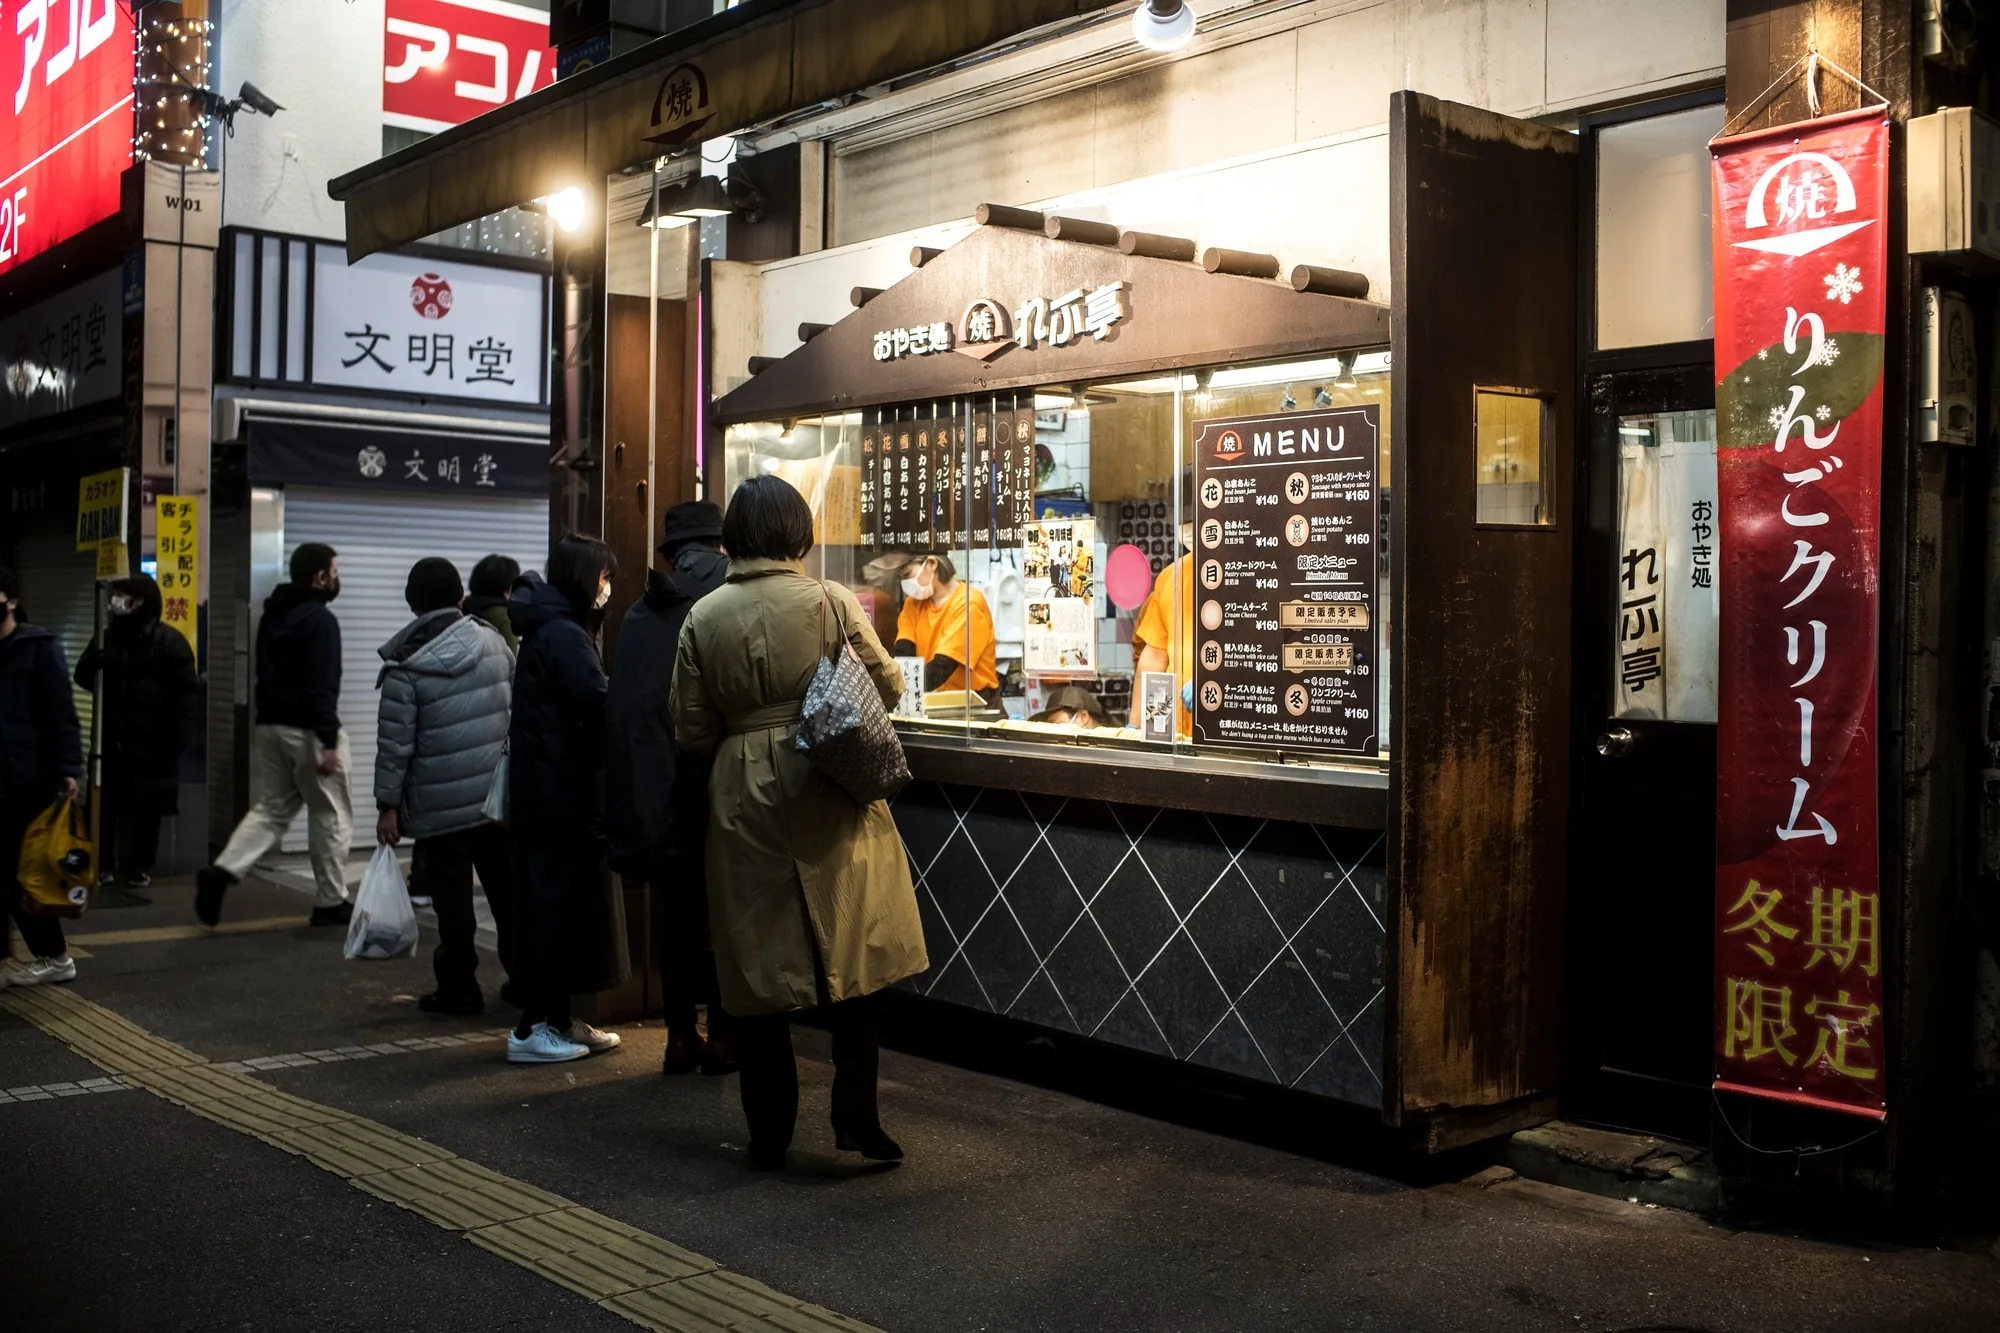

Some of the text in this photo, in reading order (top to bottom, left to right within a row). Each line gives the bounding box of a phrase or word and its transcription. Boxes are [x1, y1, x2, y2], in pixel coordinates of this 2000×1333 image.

[666, 78, 693, 122] 焼
[1774, 171, 1828, 226] 焼
[0, 186, 28, 263] 2F
[873, 321, 953, 361] おやき処
[969, 308, 994, 345] 焼
[37, 302, 107, 388] 文明堂
[342, 322, 515, 387] 文明堂
[1254, 426, 1345, 457] MENU
[404, 448, 499, 488] 文明堂
[1003, 449, 1011, 496] クリーム
[85, 479, 117, 502] カラオケ
[899, 456, 909, 511] 白あんこ
[917, 454, 927, 523] カスタード
[996, 471, 1004, 506] チーズ
[1205, 484, 1218, 502] 花
[1290, 478, 1304, 497] 秋
[1256, 495, 1278, 506] ¥140
[1345, 490, 1370, 501] ¥160
[1205, 525, 1218, 542] 雪
[1256, 537, 1278, 547] ¥140
[1345, 533, 1370, 545] ¥160
[161, 502, 176, 588] 客引き
[178, 502, 195, 589] チラシ配り
[1691, 500, 1712, 588] おやき処
[1225, 561, 1278, 570] カスタードクリーム
[1298, 555, 1357, 570] 限定メニュー
[1206, 565, 1217, 583] 月
[1256, 578, 1278, 589] ¥140
[1775, 307, 1842, 846] りんごクリーム
[1225, 602, 1268, 611] クリームチーズ
[1296, 607, 1356, 618] 限定販売予定
[1256, 620, 1278, 631] ¥160
[1337, 617, 1349, 625] plan
[1256, 662, 1278, 673] ¥160
[1205, 686, 1217, 704] 松
[1224, 684, 1275, 695] チーズ入りあんこ
[1311, 688, 1357, 699] リンゴクリーム
[1256, 703, 1278, 714] ¥180
[1290, 690, 1303, 709] 冬
[1344, 708, 1369, 719] ¥160
[1723, 879, 1880, 978] 冬期
[1724, 977, 1881, 1080] 限定
